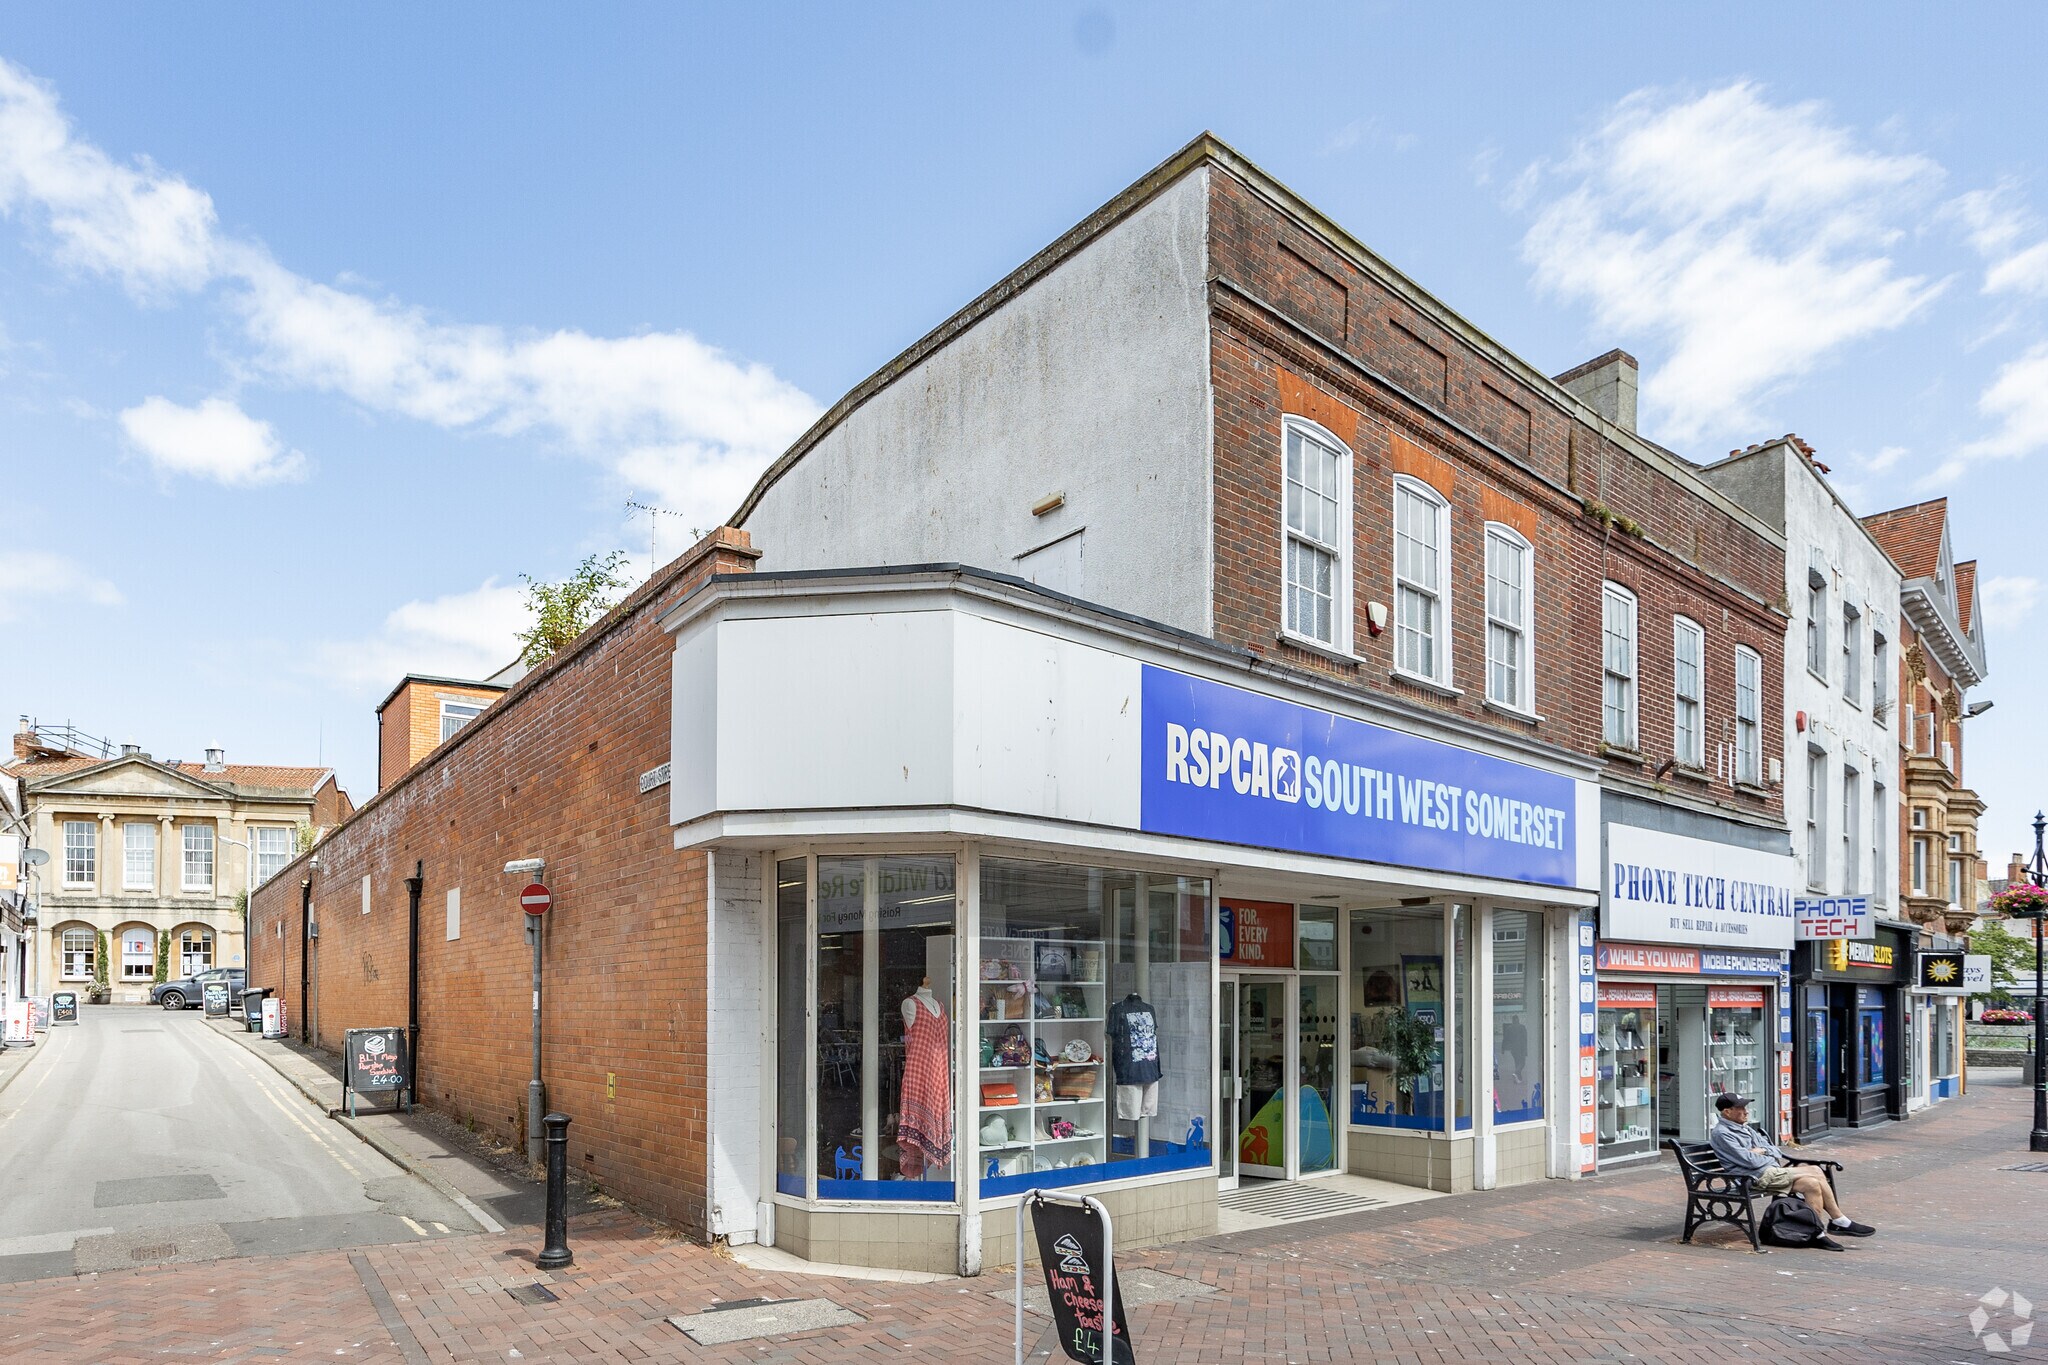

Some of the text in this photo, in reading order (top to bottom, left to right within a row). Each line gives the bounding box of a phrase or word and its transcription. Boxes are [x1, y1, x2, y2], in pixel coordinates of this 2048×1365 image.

[1167, 722, 1566, 850] RSPCA SOUTH WEST SOMERSET
[1614, 863, 1792, 917] PHONE TECH CENTRAL
[1794, 898, 1865, 917] PHONE
[1239, 926, 1268, 943] EVERY
[1670, 917, 1680, 929] BUY
[1682, 918, 1693, 930] SELL
[1696, 920, 1712, 932] REPAIR
[1720, 922, 1748, 935] ACCESSORIES
[1801, 918, 1857, 936] TECH
[1239, 943, 1265, 960] KIND.
[1609, 948, 1695, 968] WHILE YOU WAIT
[1849, 941, 1893, 964] MERKUR SLOTS
[1703, 954, 1731, 970] MOBILE
[1731, 956, 1756, 971] PHONE
[1049, 1268, 1095, 1297] Ham &
